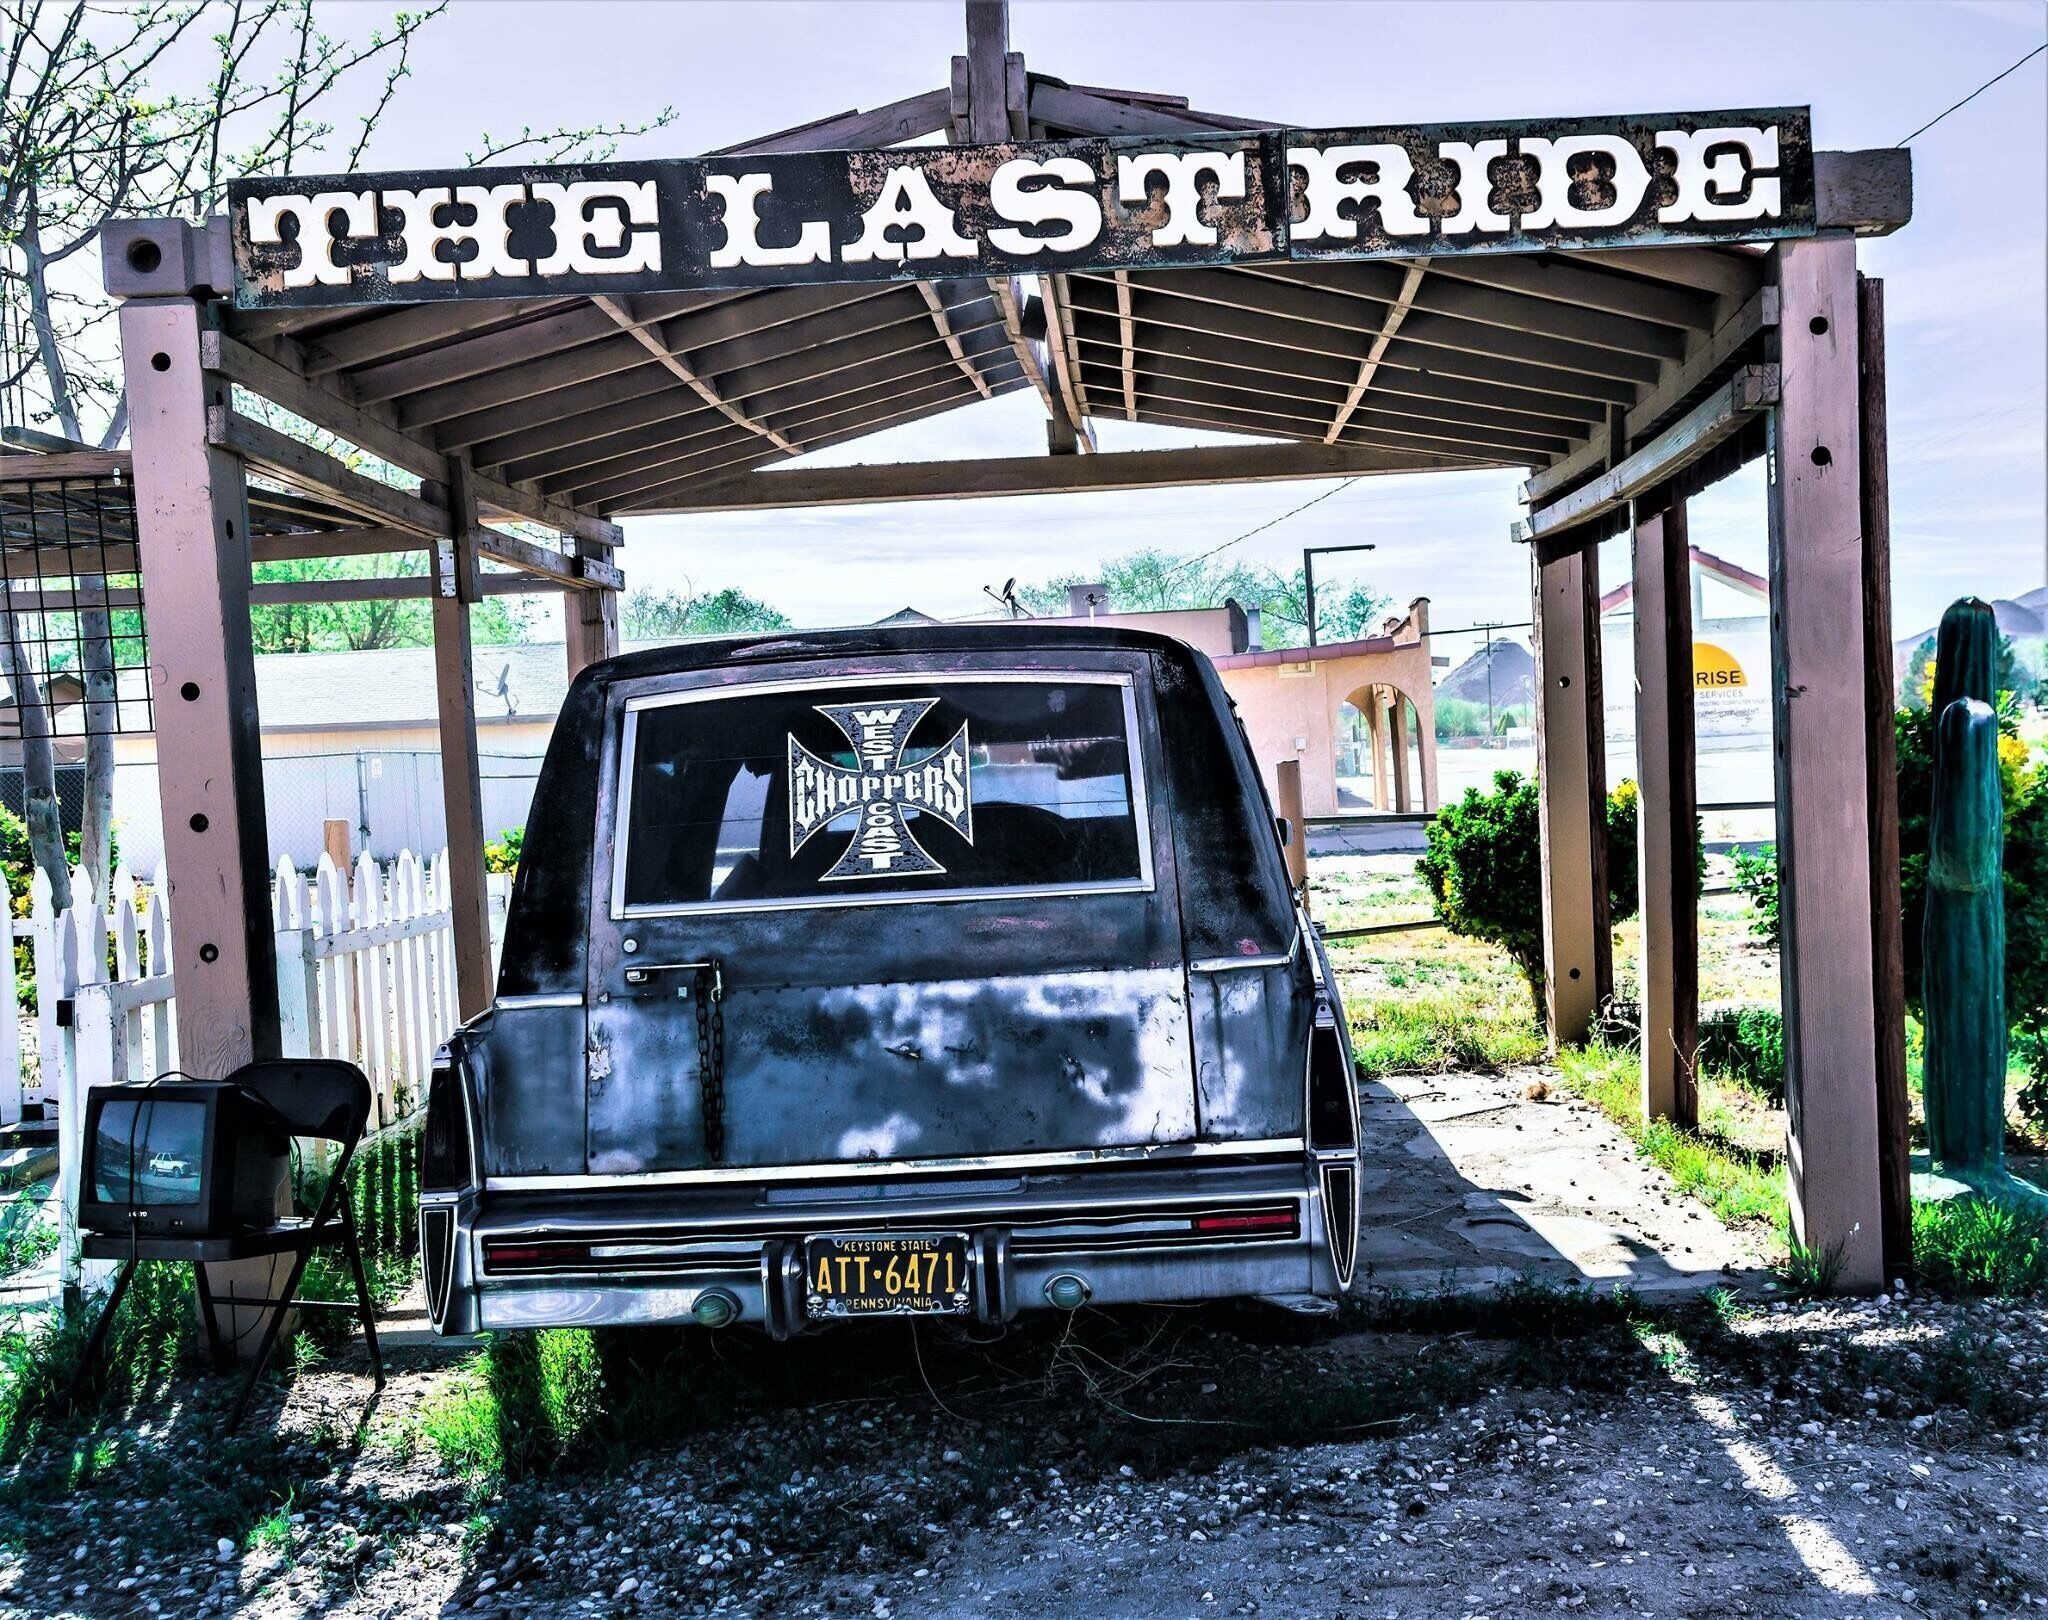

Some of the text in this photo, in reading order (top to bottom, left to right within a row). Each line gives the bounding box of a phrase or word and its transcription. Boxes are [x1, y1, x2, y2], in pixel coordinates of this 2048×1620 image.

[247, 126, 1781, 288] THE LAST RIDE
[1700, 689, 1744, 699] SERVICES
[852, 708, 904, 771] WEST
[794, 746, 966, 833] CHOPPERS
[858, 802, 904, 869] COAST
[844, 1240, 931, 1252] KEYSTONE STATE
